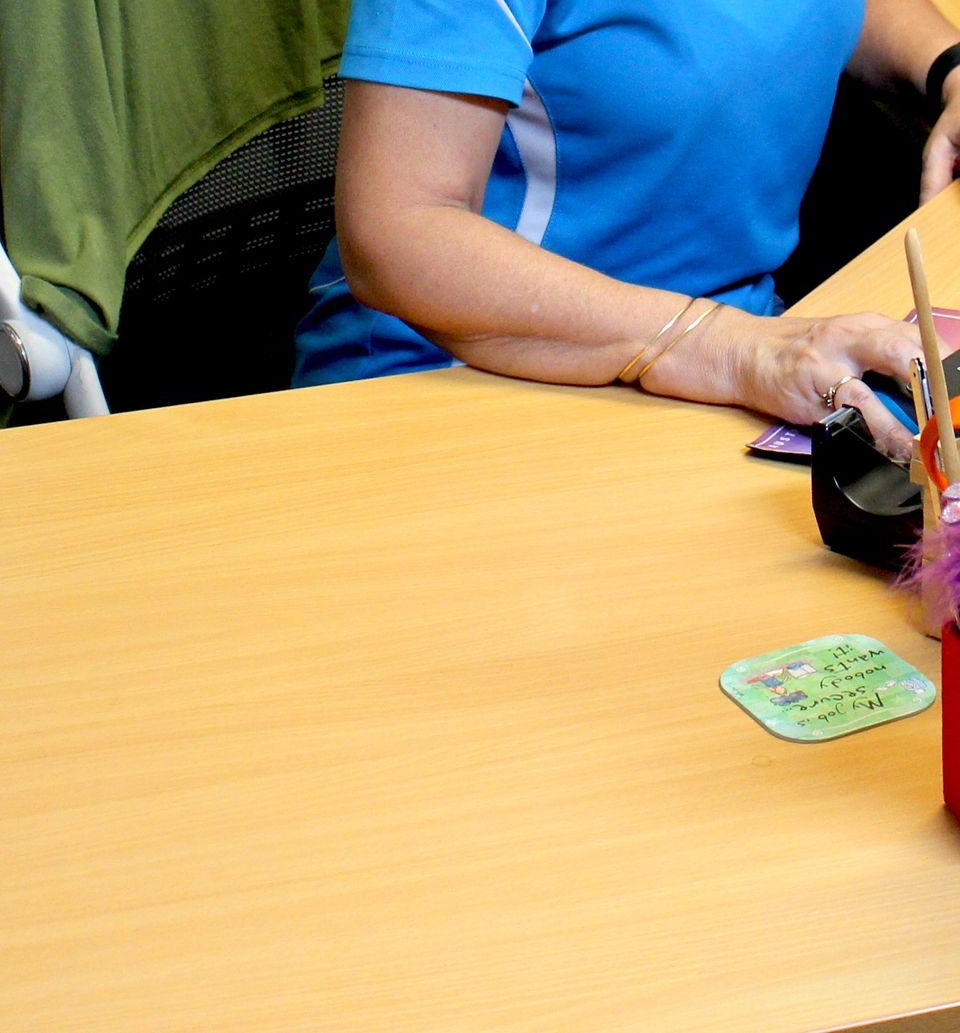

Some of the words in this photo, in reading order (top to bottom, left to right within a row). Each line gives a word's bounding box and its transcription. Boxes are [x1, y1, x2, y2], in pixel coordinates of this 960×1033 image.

[823, 649, 885, 673] wants
[827, 644, 854, 659] it!
[820, 665, 887, 689] nobody
[781, 685, 866, 713] secure...
[852, 692, 884, 710] My
[797, 717, 813, 727] is
